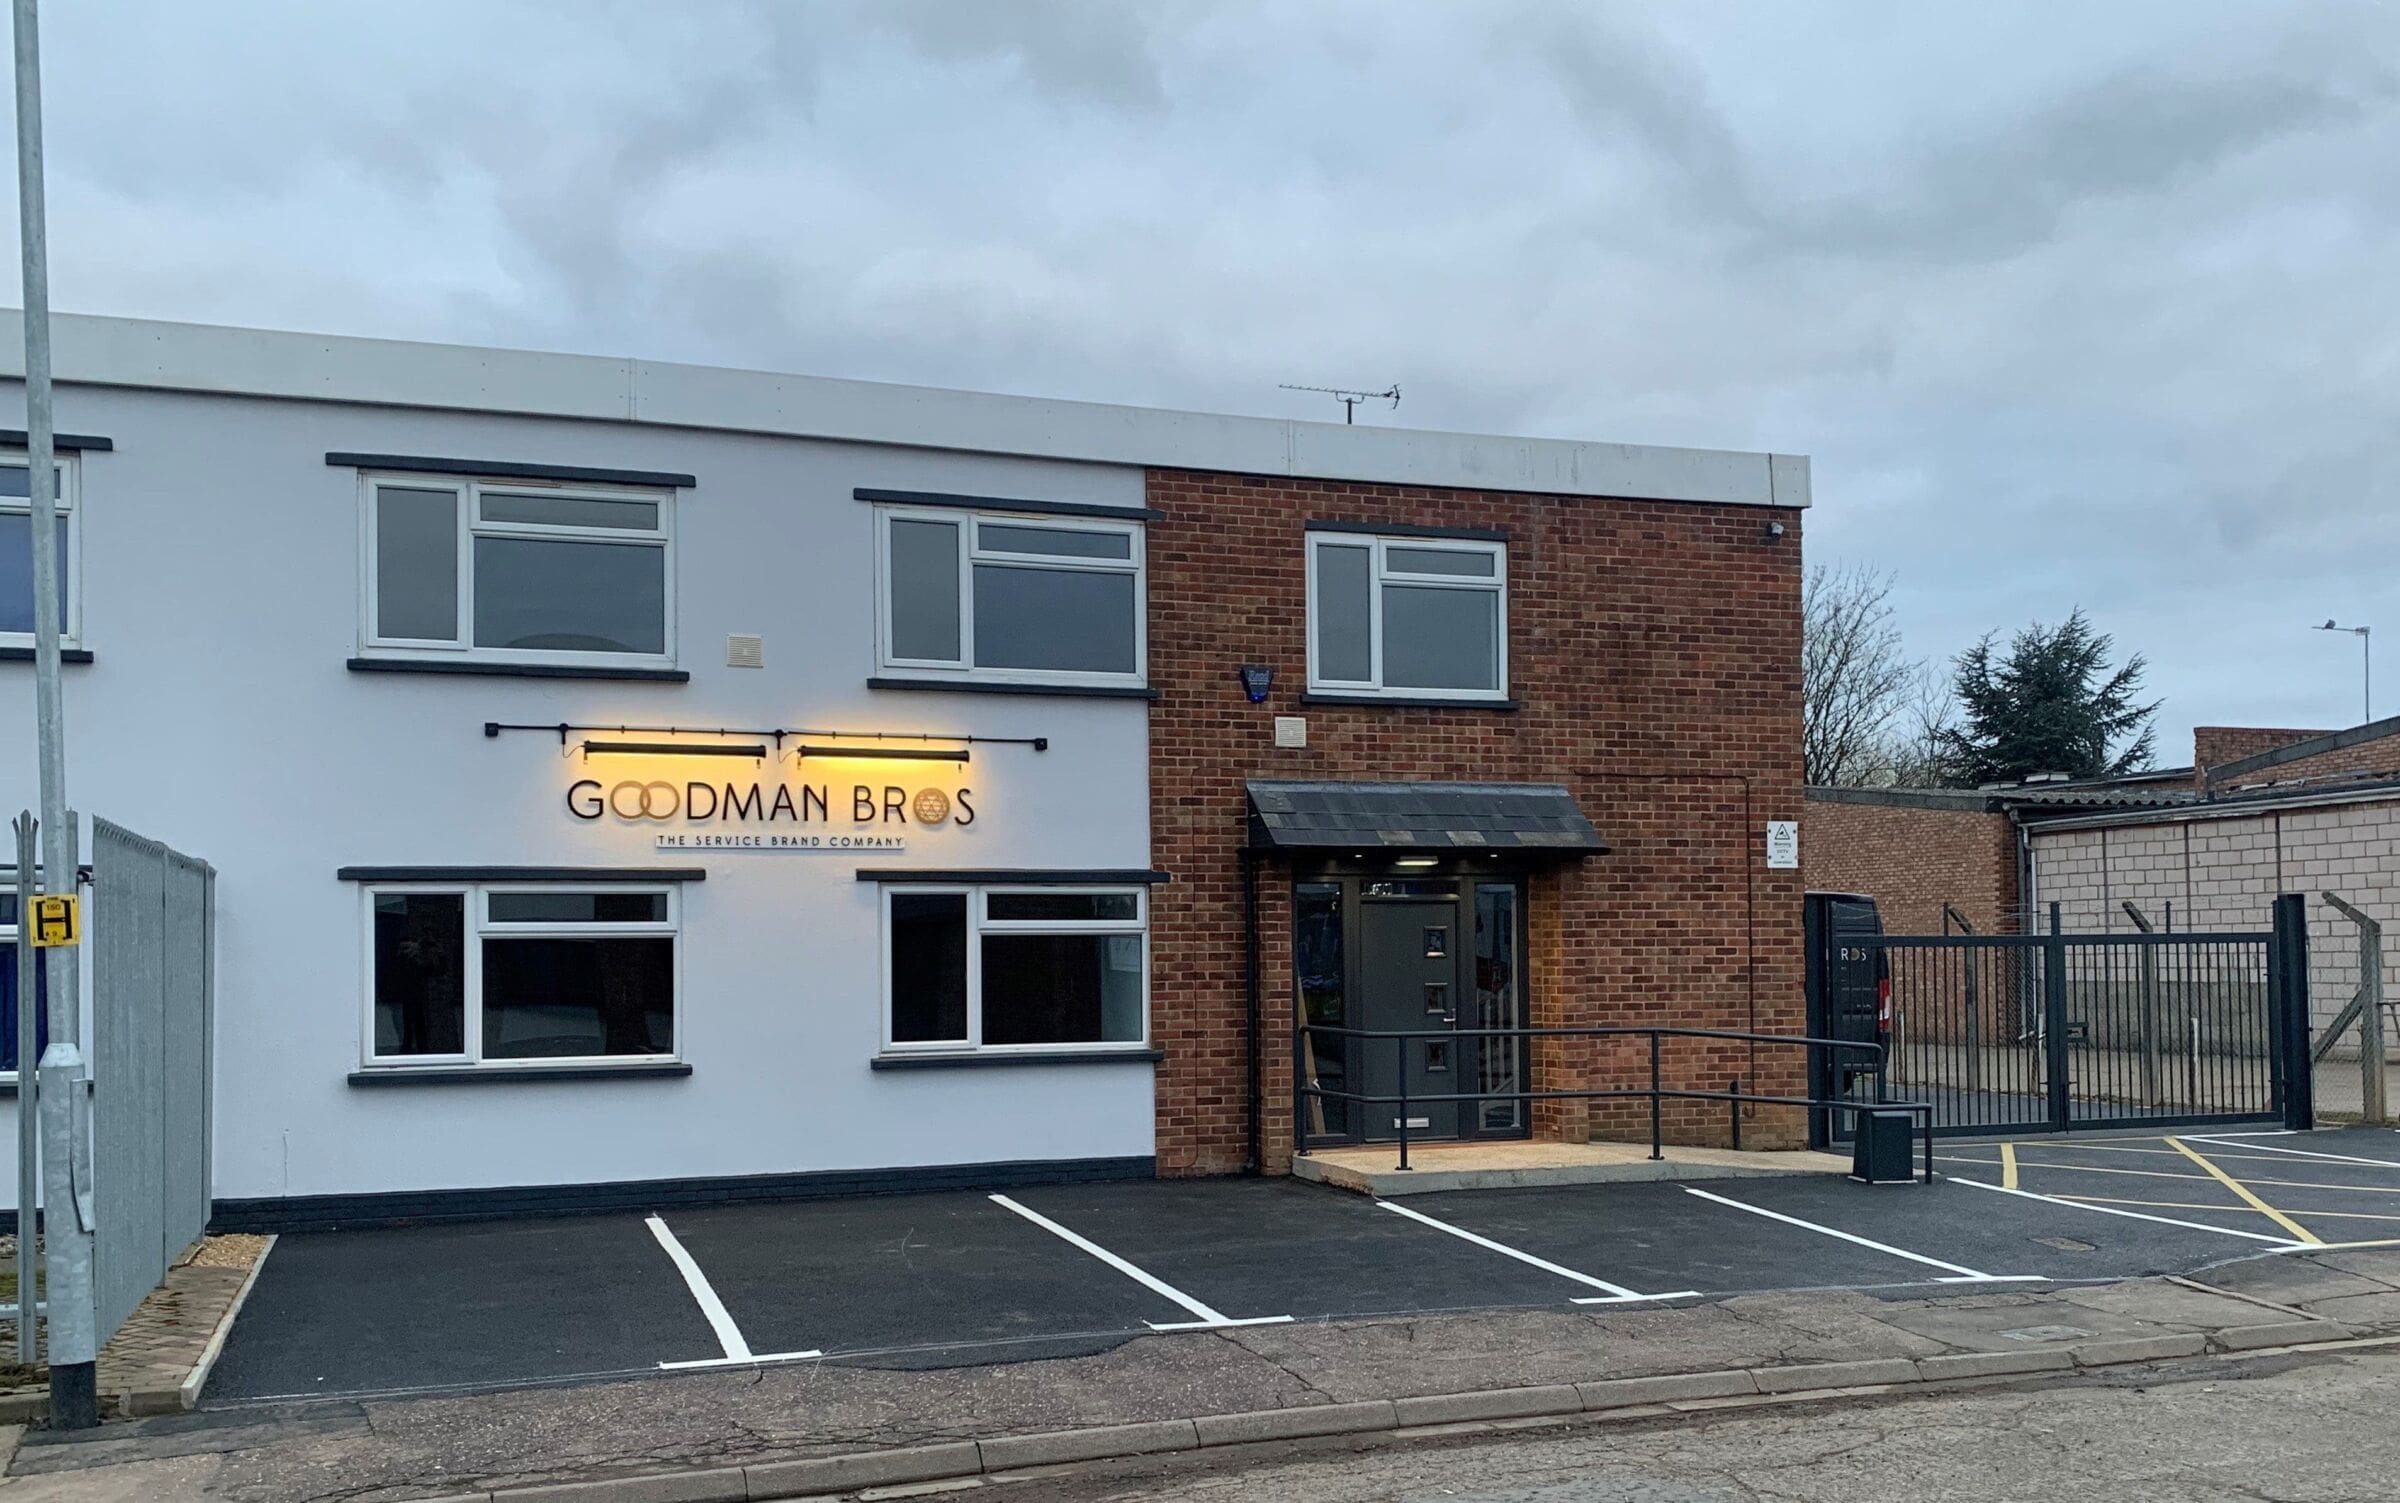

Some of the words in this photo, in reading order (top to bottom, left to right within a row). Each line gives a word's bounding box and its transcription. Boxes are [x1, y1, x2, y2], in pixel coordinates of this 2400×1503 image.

[567, 779, 828, 822] GOODMAN
[853, 784, 975, 826] BROS
[658, 834, 685, 846] THE
[696, 834, 761, 847] SERVICE
[771, 836, 820, 847] BRAND
[829, 836, 903, 848] COMPANY
